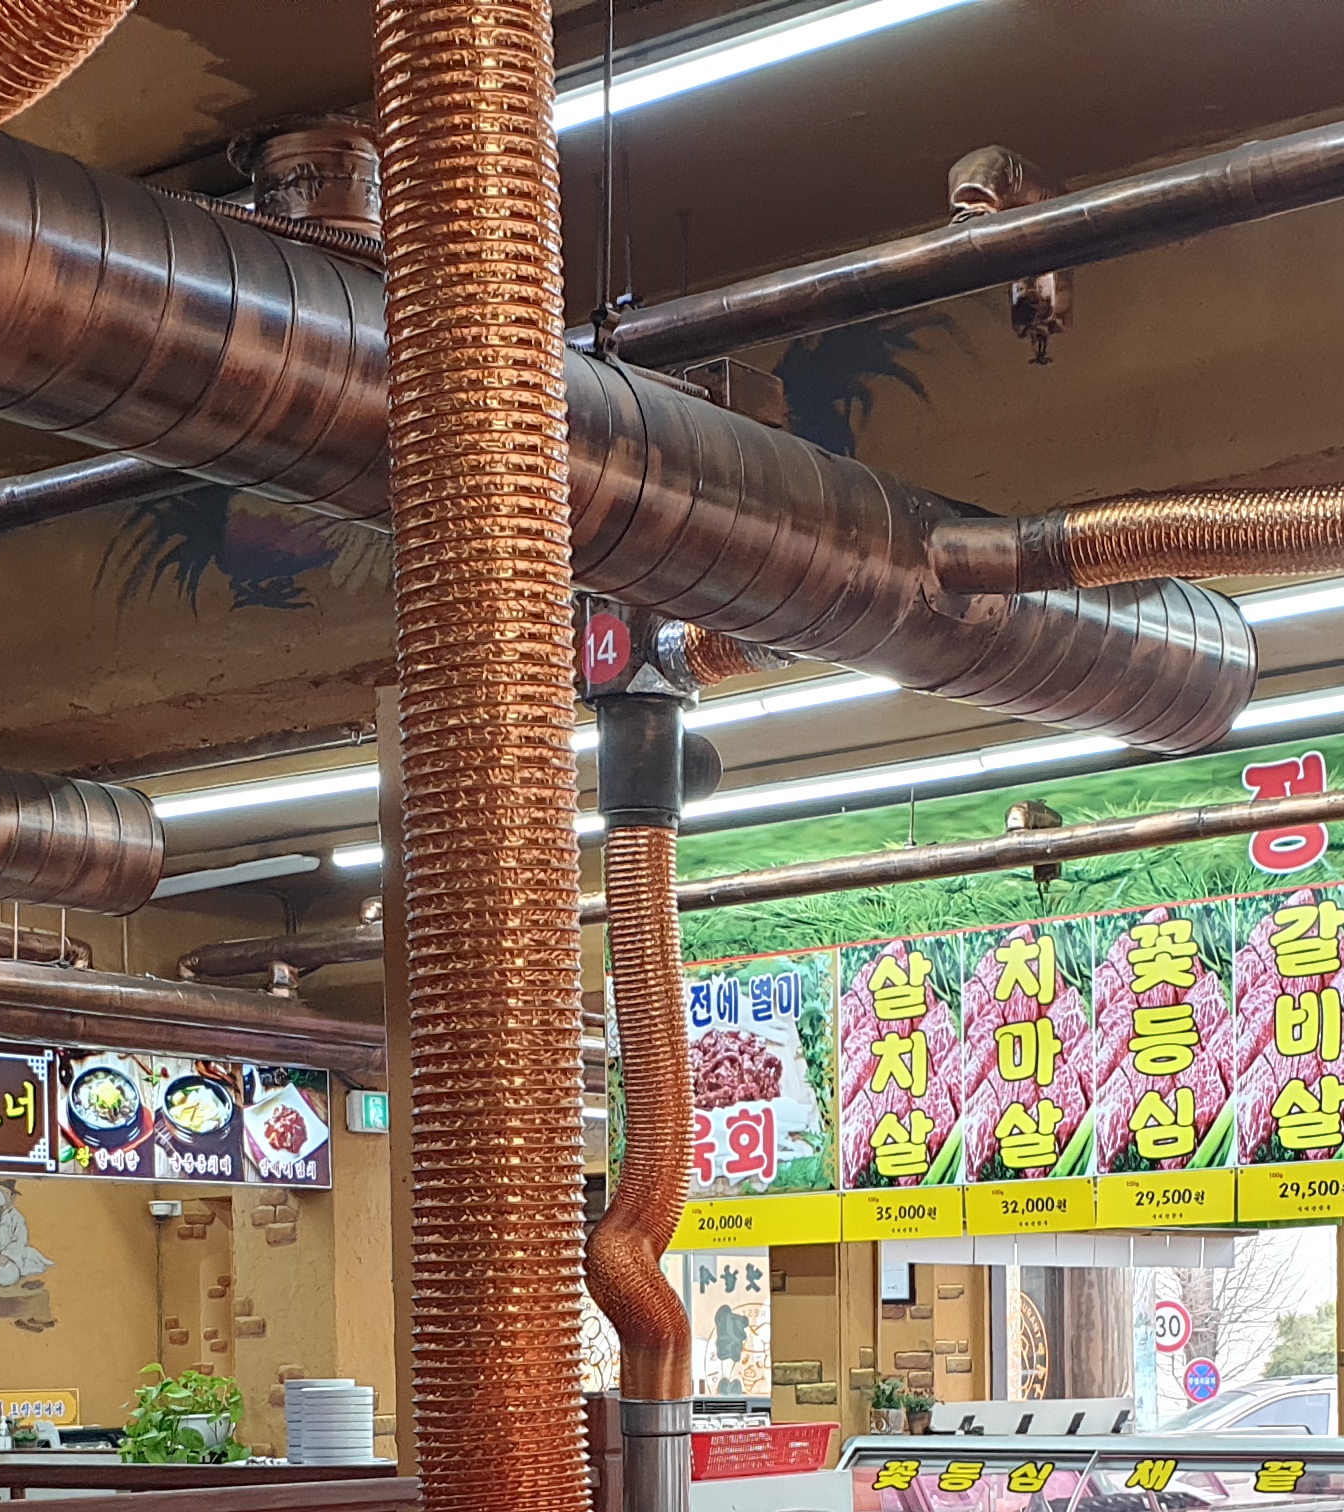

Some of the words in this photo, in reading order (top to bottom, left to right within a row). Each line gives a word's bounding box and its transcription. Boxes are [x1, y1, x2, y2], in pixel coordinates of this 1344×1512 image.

[587, 630, 617, 667] 14
[750, 973, 801, 1024] 별미
[993, 934, 1064, 1170] 치마살
[1128, 916, 1199, 1159] 꽃등심
[868, 951, 934, 1177] 살치살
[875, 1204, 937, 1222] 35,000원
[1001, 1196, 1067, 1215] 32,000원
[1135, 1188, 1205, 1208] 29,500원
[698, 1215, 753, 1231] 20,000원
[1156, 1315, 1181, 1338] 30
[872, 1459, 1055, 1493] 꽃등심
